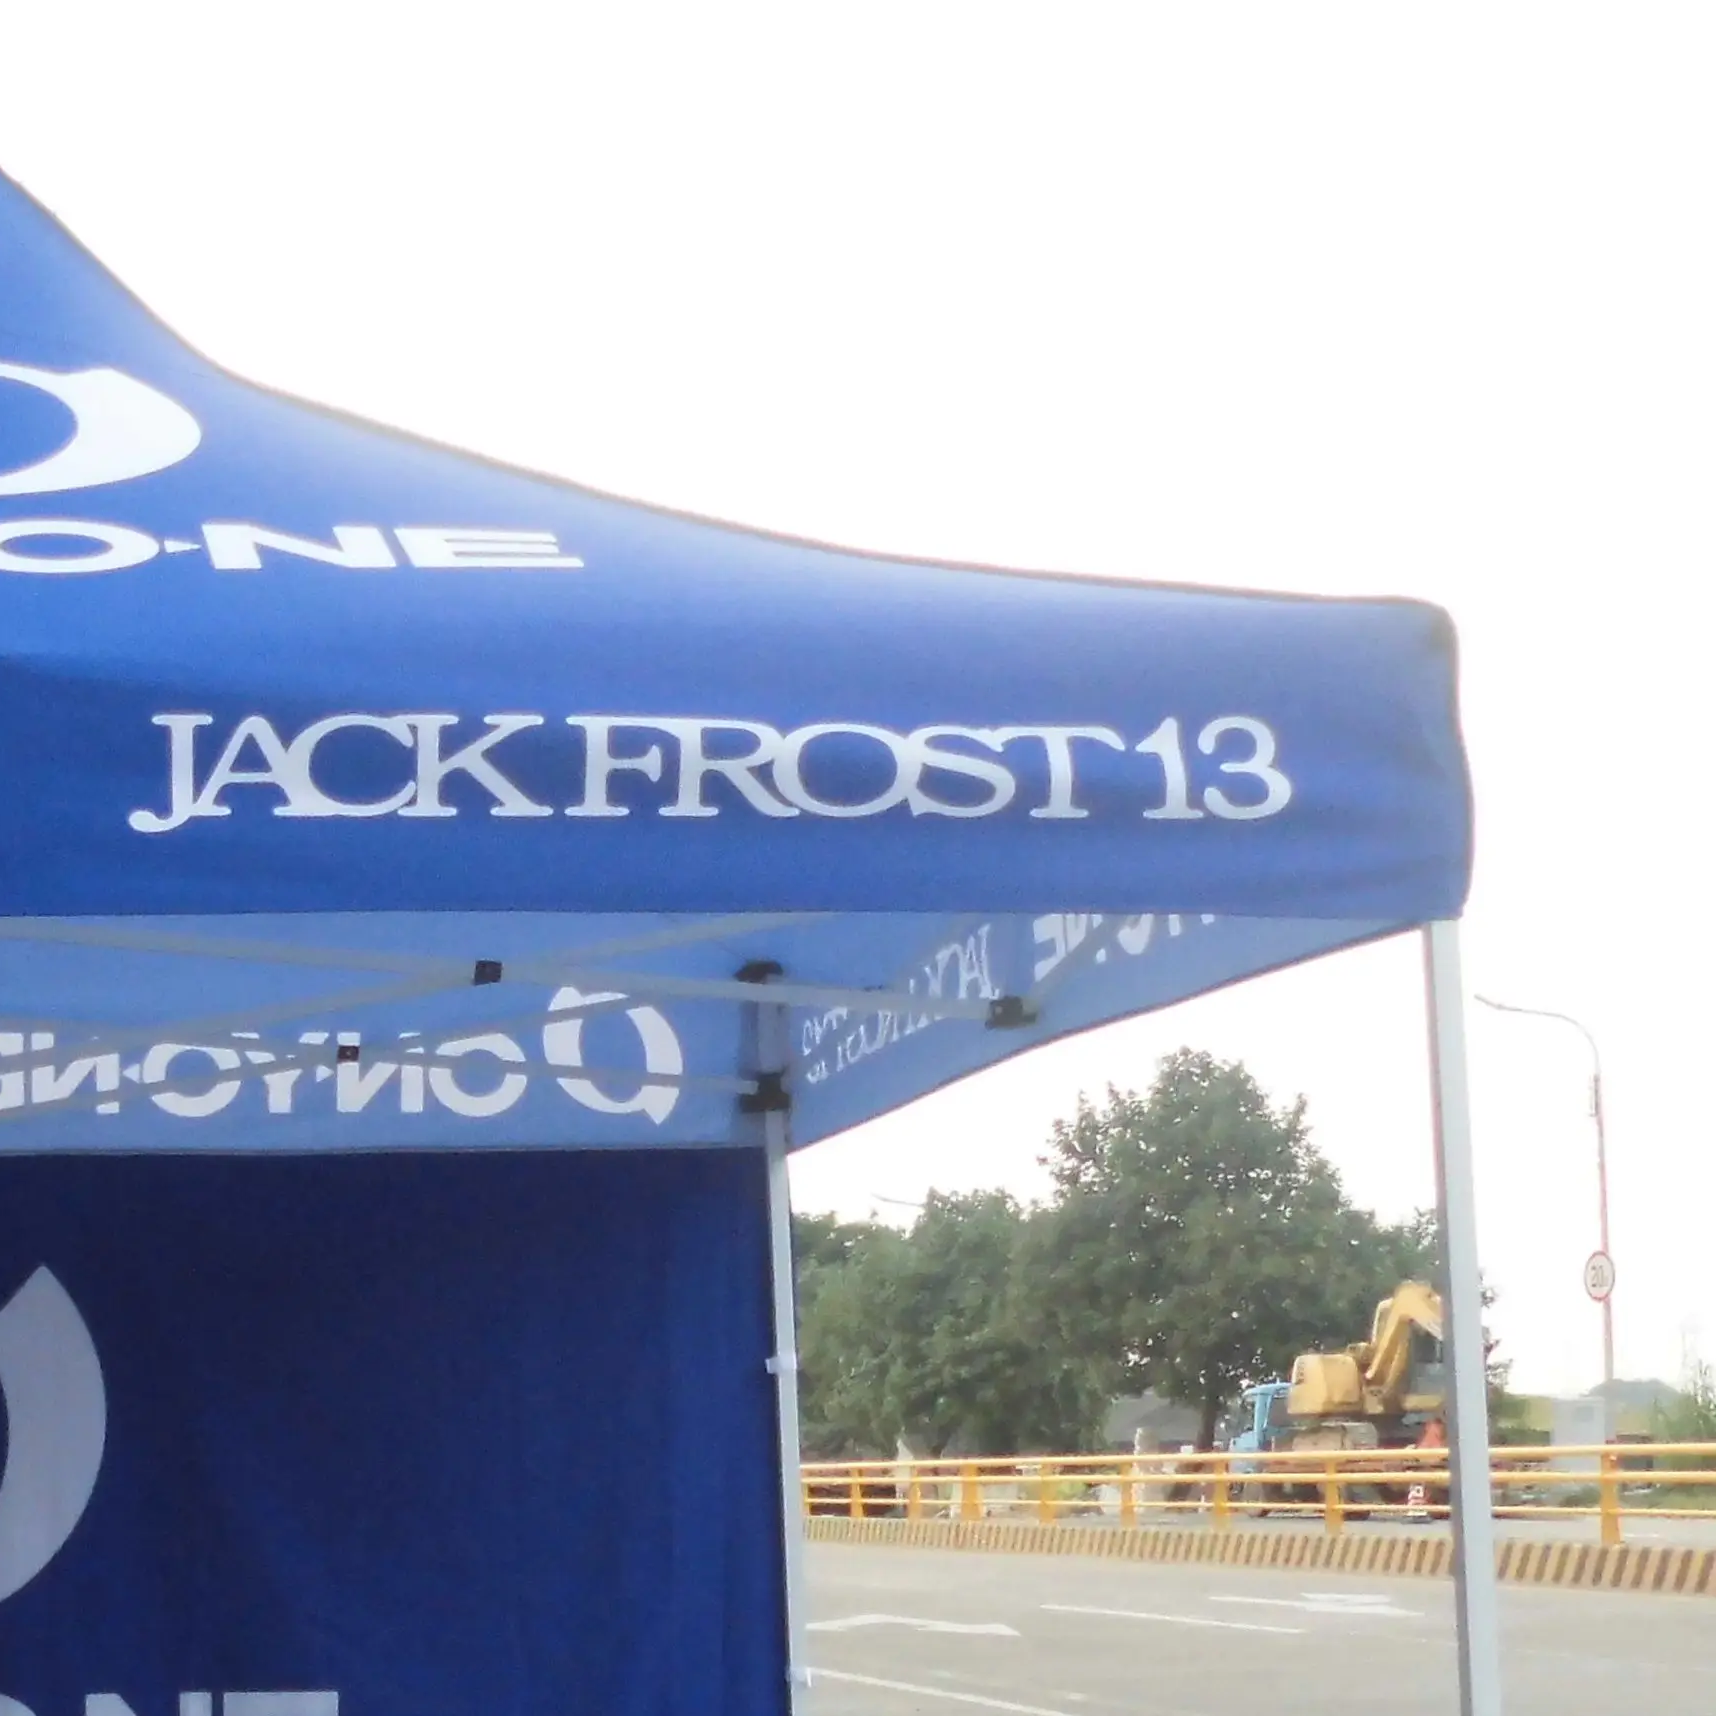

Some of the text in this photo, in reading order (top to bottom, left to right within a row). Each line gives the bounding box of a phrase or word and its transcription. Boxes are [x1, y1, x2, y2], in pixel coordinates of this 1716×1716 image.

[128, 713, 1294, 833] JACK FROST 13
